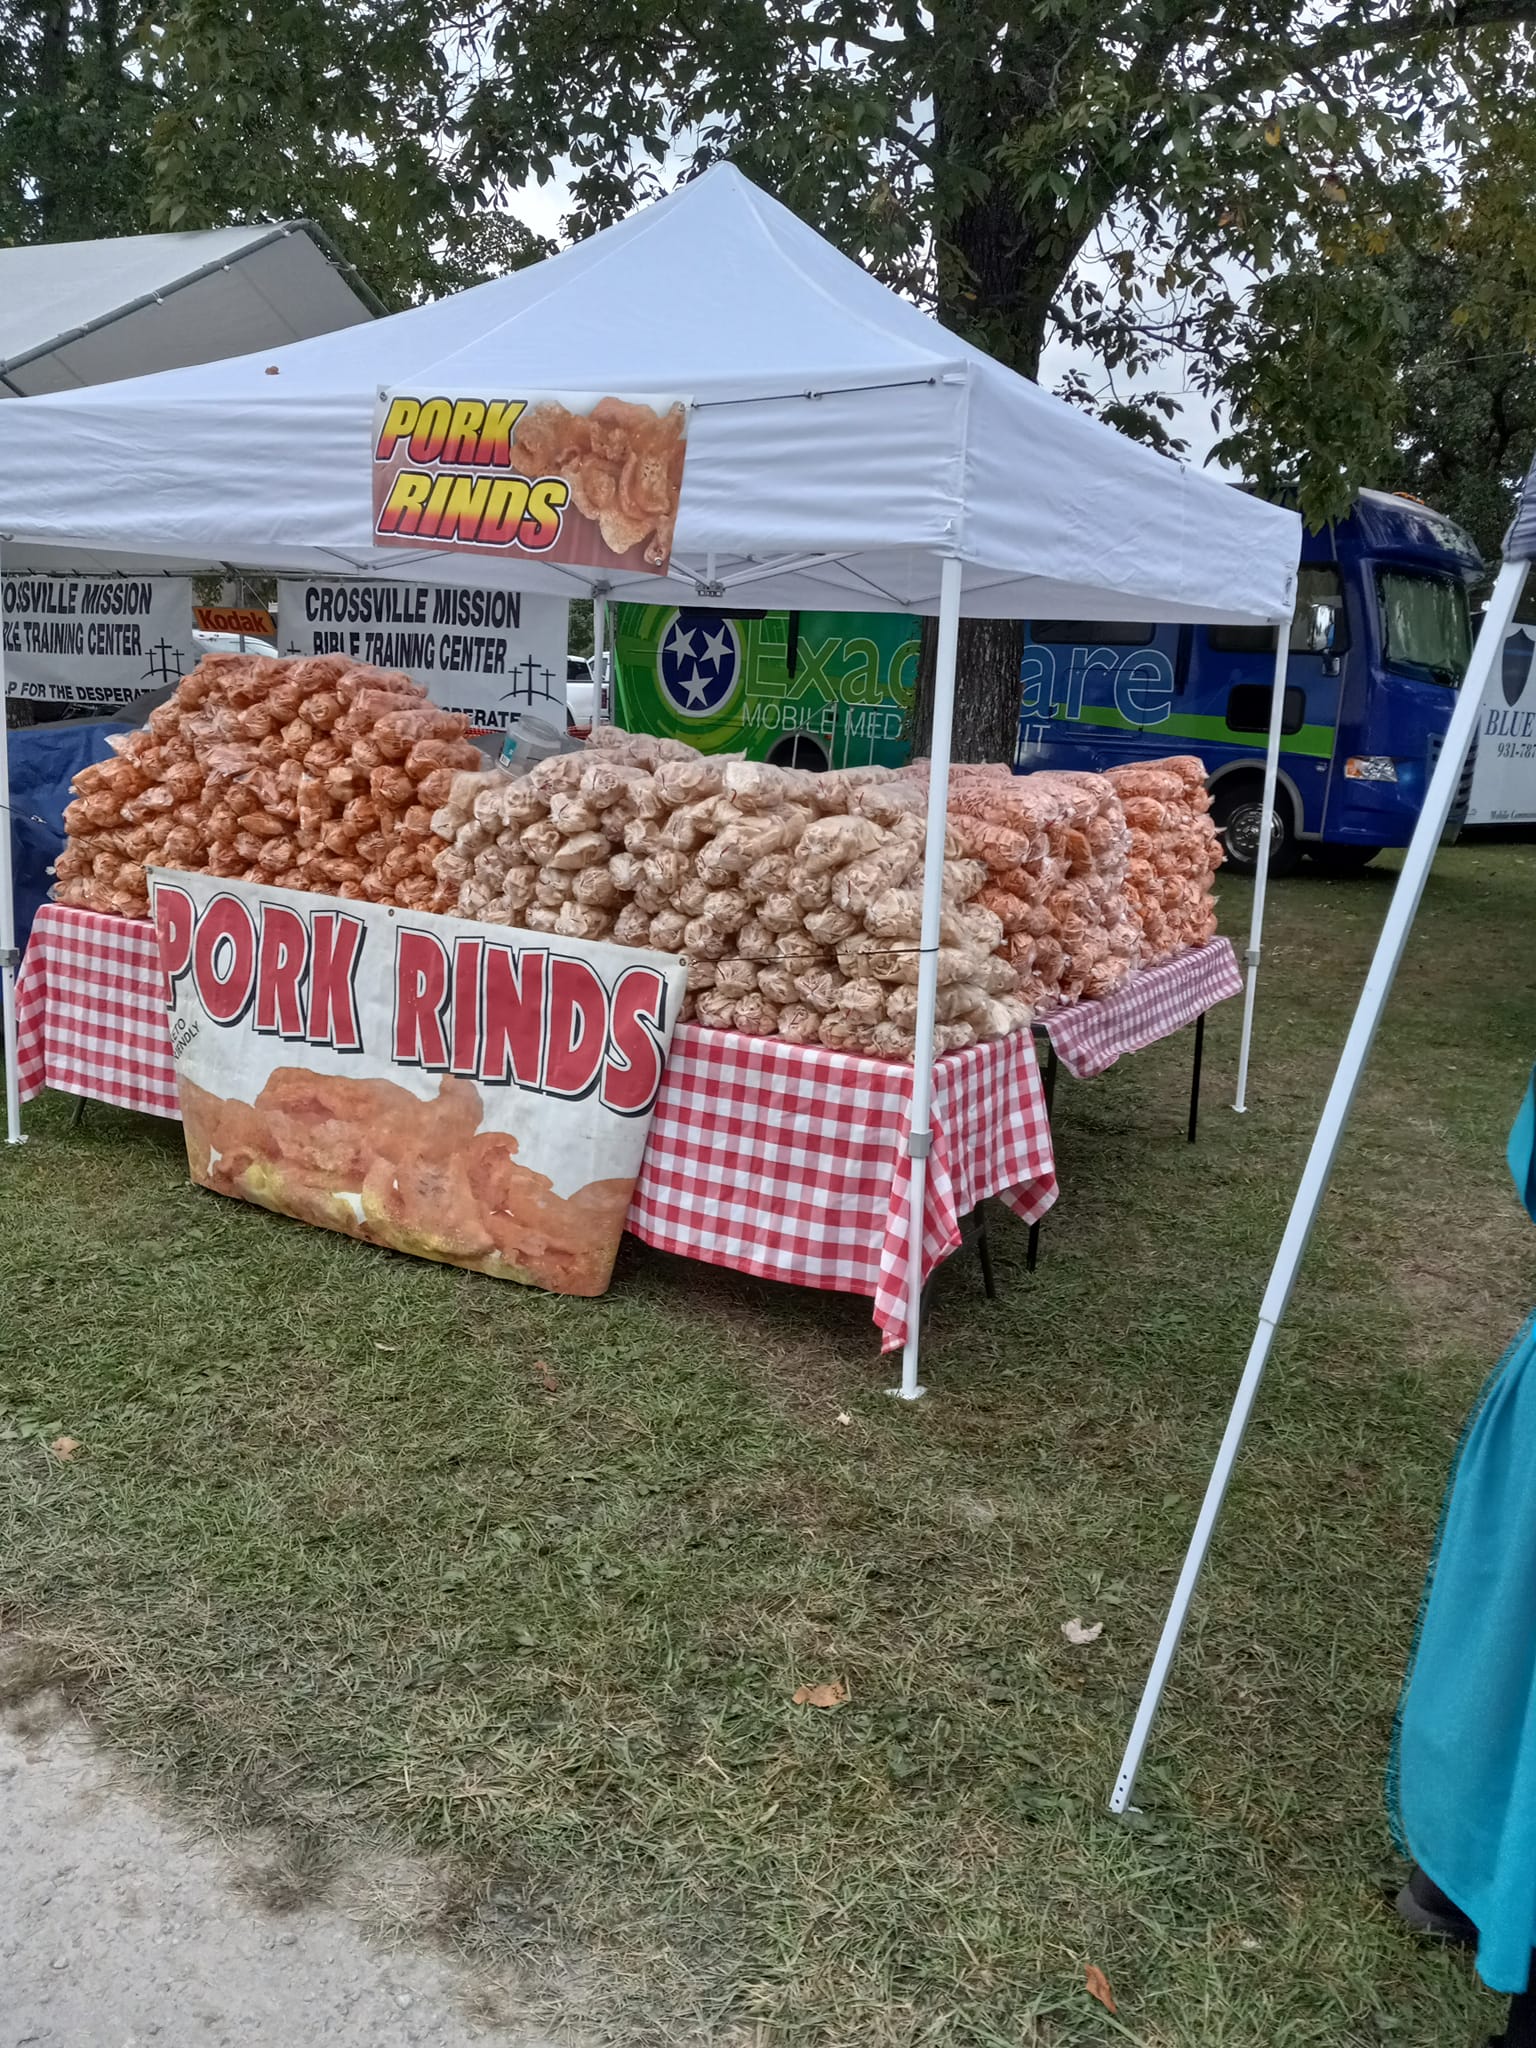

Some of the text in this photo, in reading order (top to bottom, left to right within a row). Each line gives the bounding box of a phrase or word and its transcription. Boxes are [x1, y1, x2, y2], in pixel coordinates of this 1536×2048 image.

[375, 396, 528, 469] PORK
[376, 468, 571, 552] RINDS
[81, 583, 152, 615] MISSION
[305, 586, 521, 629] CROSSVILLE MISSION
[198, 608, 269, 633] Kodak
[87, 623, 142, 656] CENTER
[439, 634, 507, 674] CENTER
[20, 682, 46, 698] FOR
[50, 684, 74, 700] THE
[742, 702, 834, 735] MOBILE
[1484, 708, 1536, 738] BLUE
[153, 881, 668, 1118] PORK RINDS
